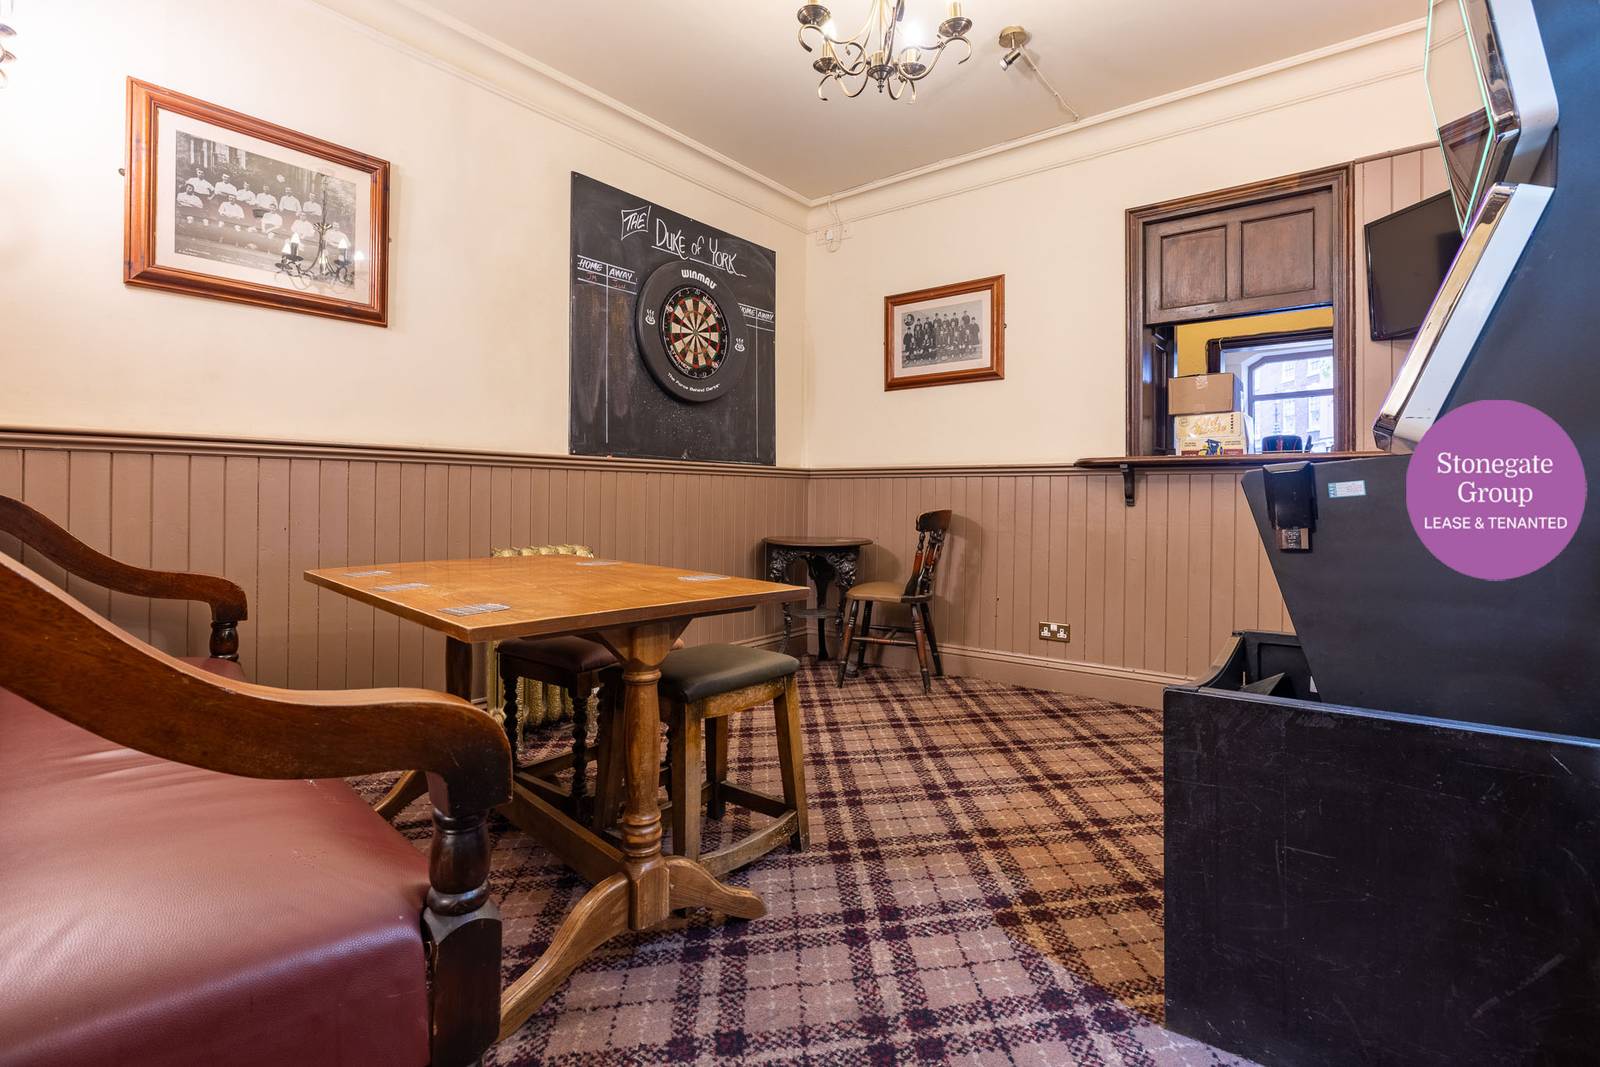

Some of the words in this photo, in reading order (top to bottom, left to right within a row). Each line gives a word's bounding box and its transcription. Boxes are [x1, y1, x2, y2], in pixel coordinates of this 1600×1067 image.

[623, 212, 647, 231] THE
[656, 218, 686, 260] DUKE
[709, 237, 743, 277] YORK
[578, 258, 603, 272] HOME
[609, 268, 633, 281] AWAY
[681, 269, 717, 288] WINMAU
